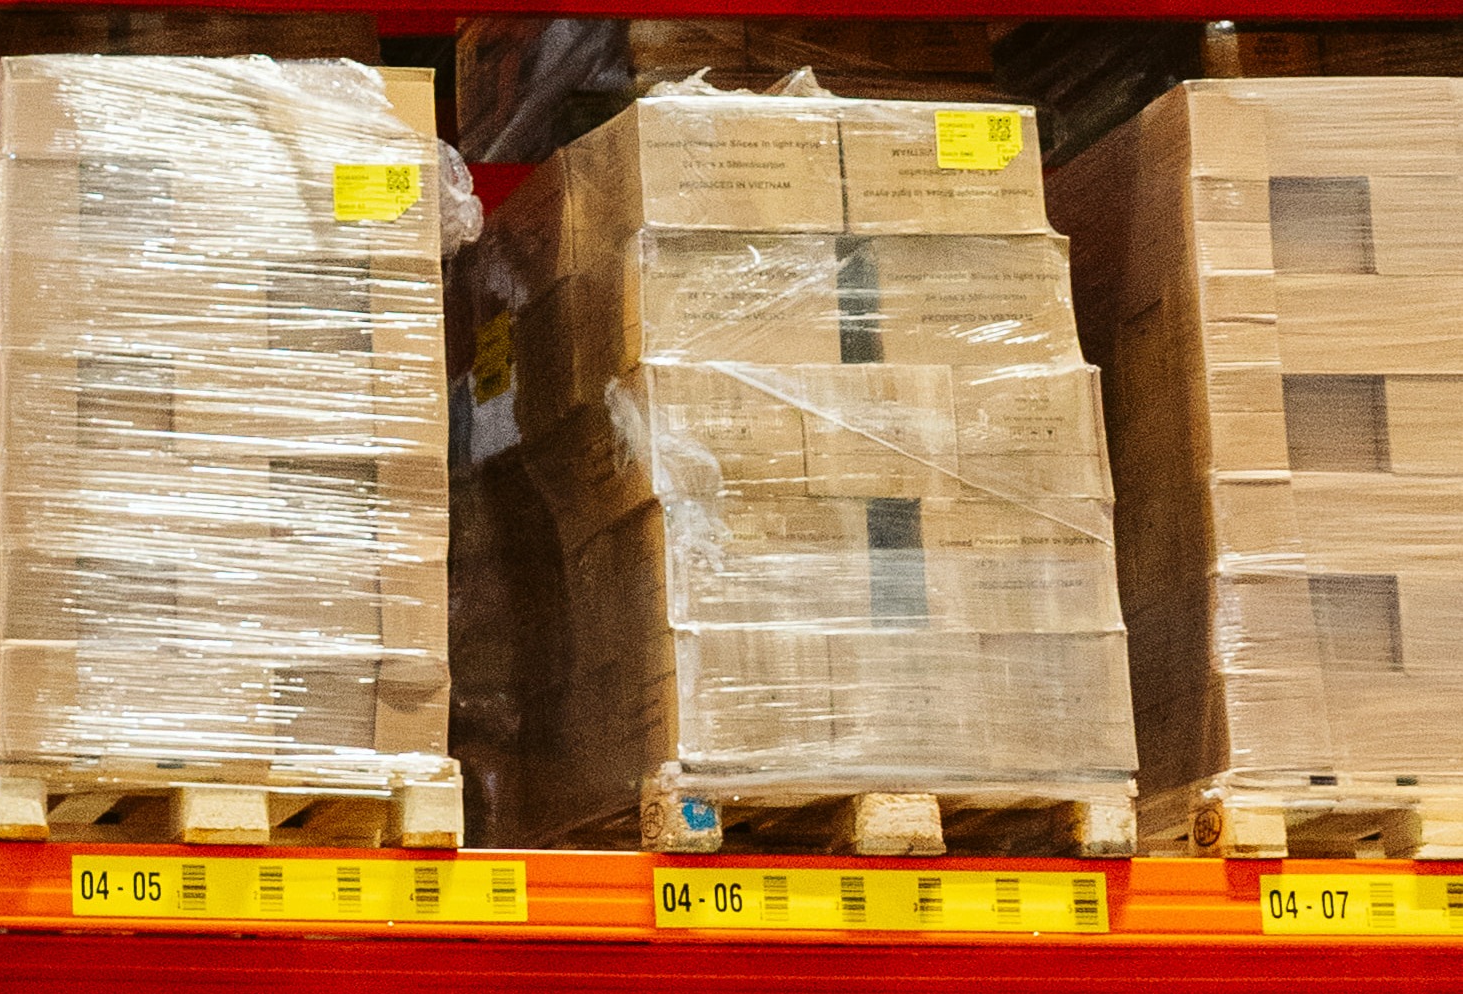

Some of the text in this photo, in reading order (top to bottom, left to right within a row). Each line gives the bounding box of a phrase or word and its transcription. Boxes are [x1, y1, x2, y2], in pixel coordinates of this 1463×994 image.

[747, 181, 791, 190] VIETNAM
[81, 870, 109, 900] 04
[133, 871, 162, 901] 05
[662, 882, 692, 912] 04
[714, 882, 743, 913] 06
[1269, 889, 1298, 919] 04
[1321, 890, 1349, 919] 07
